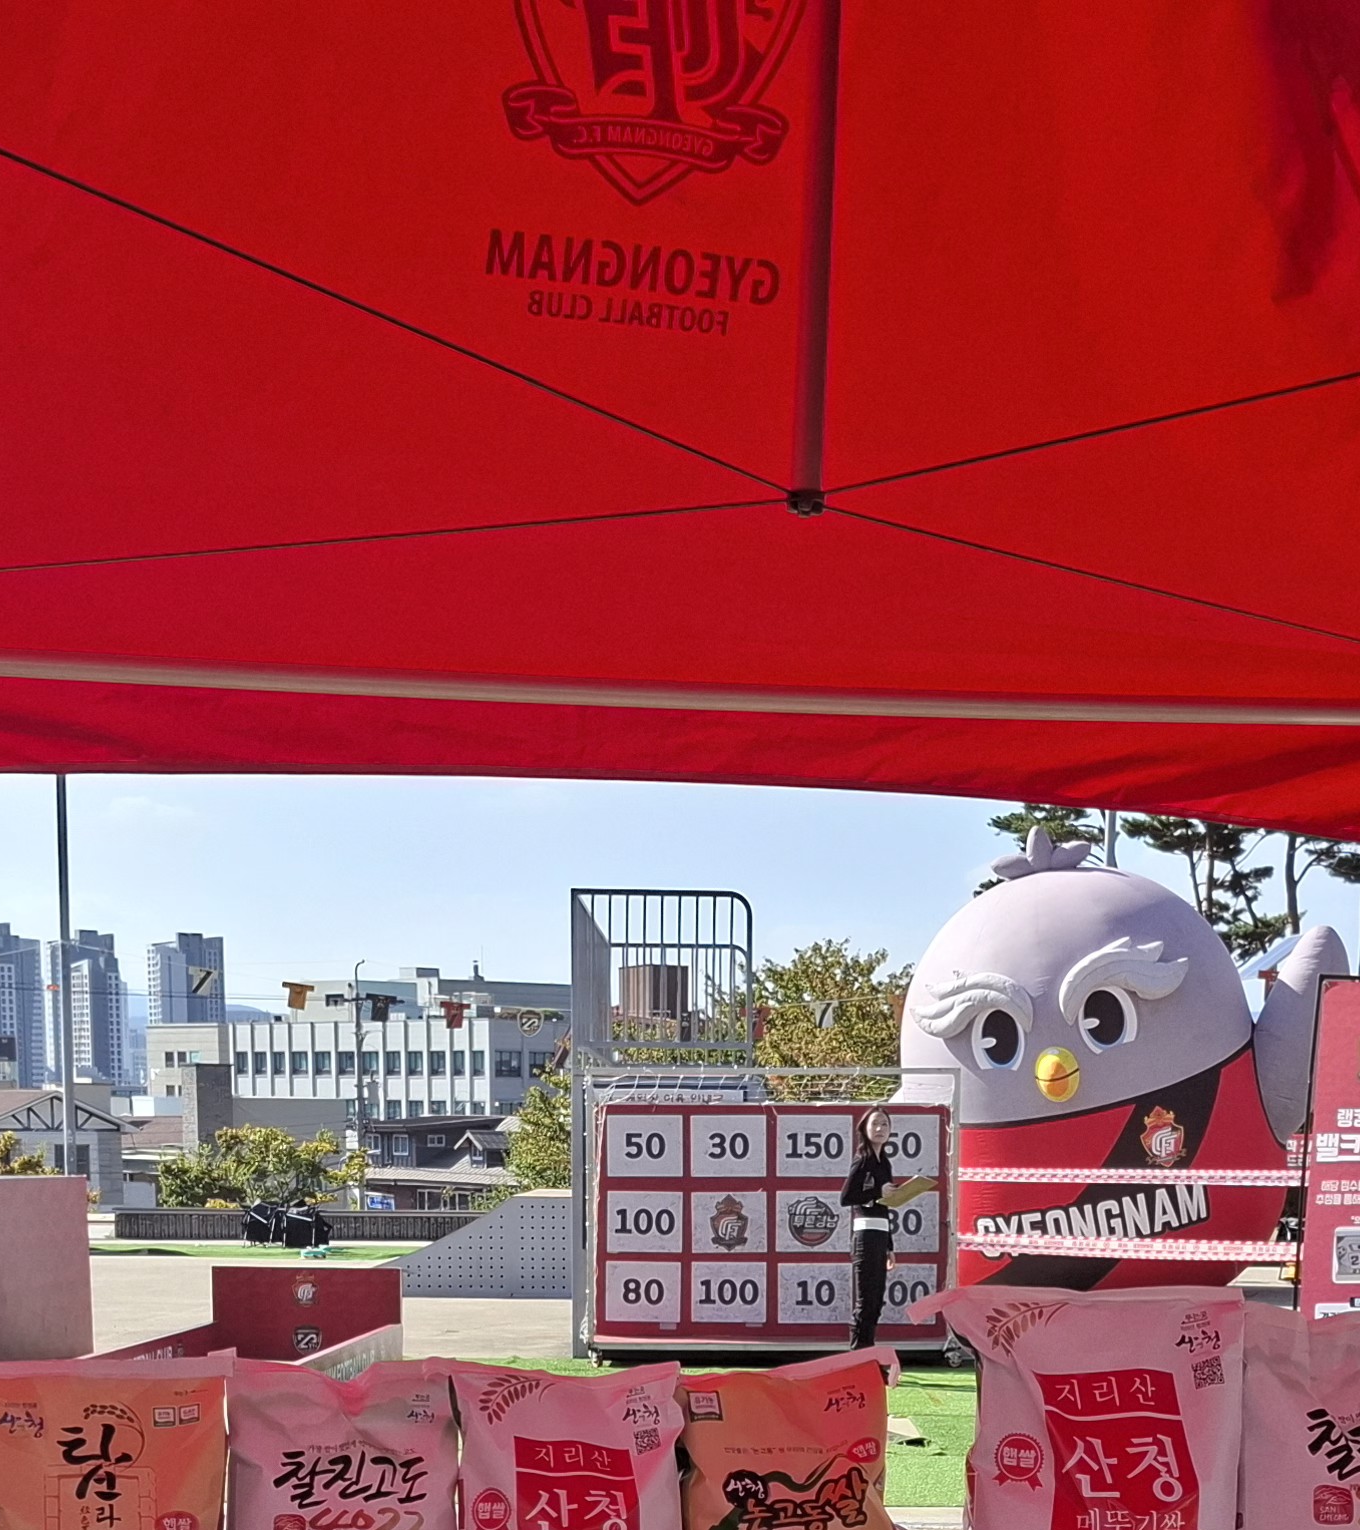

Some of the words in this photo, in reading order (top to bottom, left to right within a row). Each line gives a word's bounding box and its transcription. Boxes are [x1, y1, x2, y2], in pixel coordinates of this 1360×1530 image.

[624, 1132, 666, 1159] 50
[708, 1132, 750, 1159] 30
[784, 1132, 844, 1160] 150
[614, 1208, 676, 1236] 100
[976, 1182, 1209, 1257] GYEONGNAM
[622, 1278, 665, 1306] 80
[698, 1278, 760, 1306] 100
[795, 1280, 836, 1307] 10
[1055, 1376, 1157, 1410] 지리산
[534, 1444, 612, 1472] 지리산
[1002, 1447, 1036, 1468] 햅쌀
[1061, 1433, 1183, 1500] 산청
[272, 1449, 429, 1511] 찰진고도
[477, 1501, 506, 1520] 햅쌀
